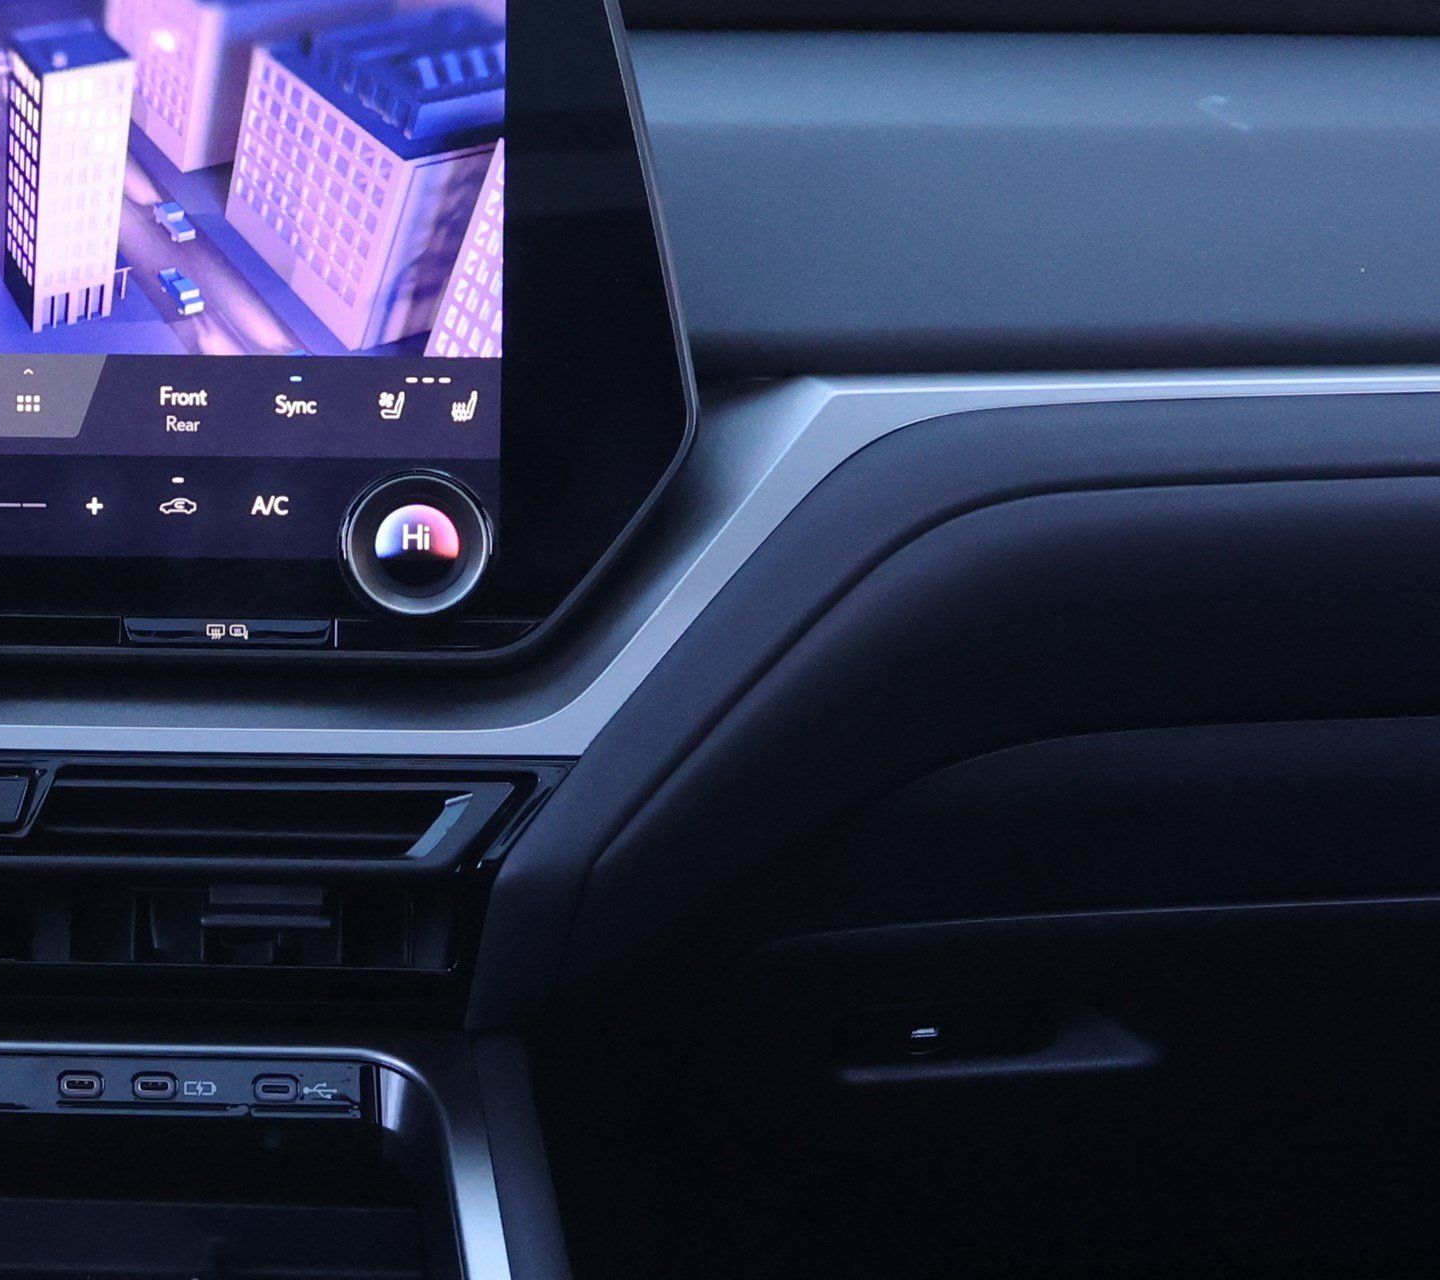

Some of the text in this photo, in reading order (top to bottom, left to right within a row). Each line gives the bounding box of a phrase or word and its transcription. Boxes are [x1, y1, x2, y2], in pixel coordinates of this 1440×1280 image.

[159, 387, 208, 408] Front
[275, 395, 317, 418] Sync
[166, 415, 201, 433] Rear
[251, 495, 289, 517] A/C
[402, 524, 431, 551] Hi
